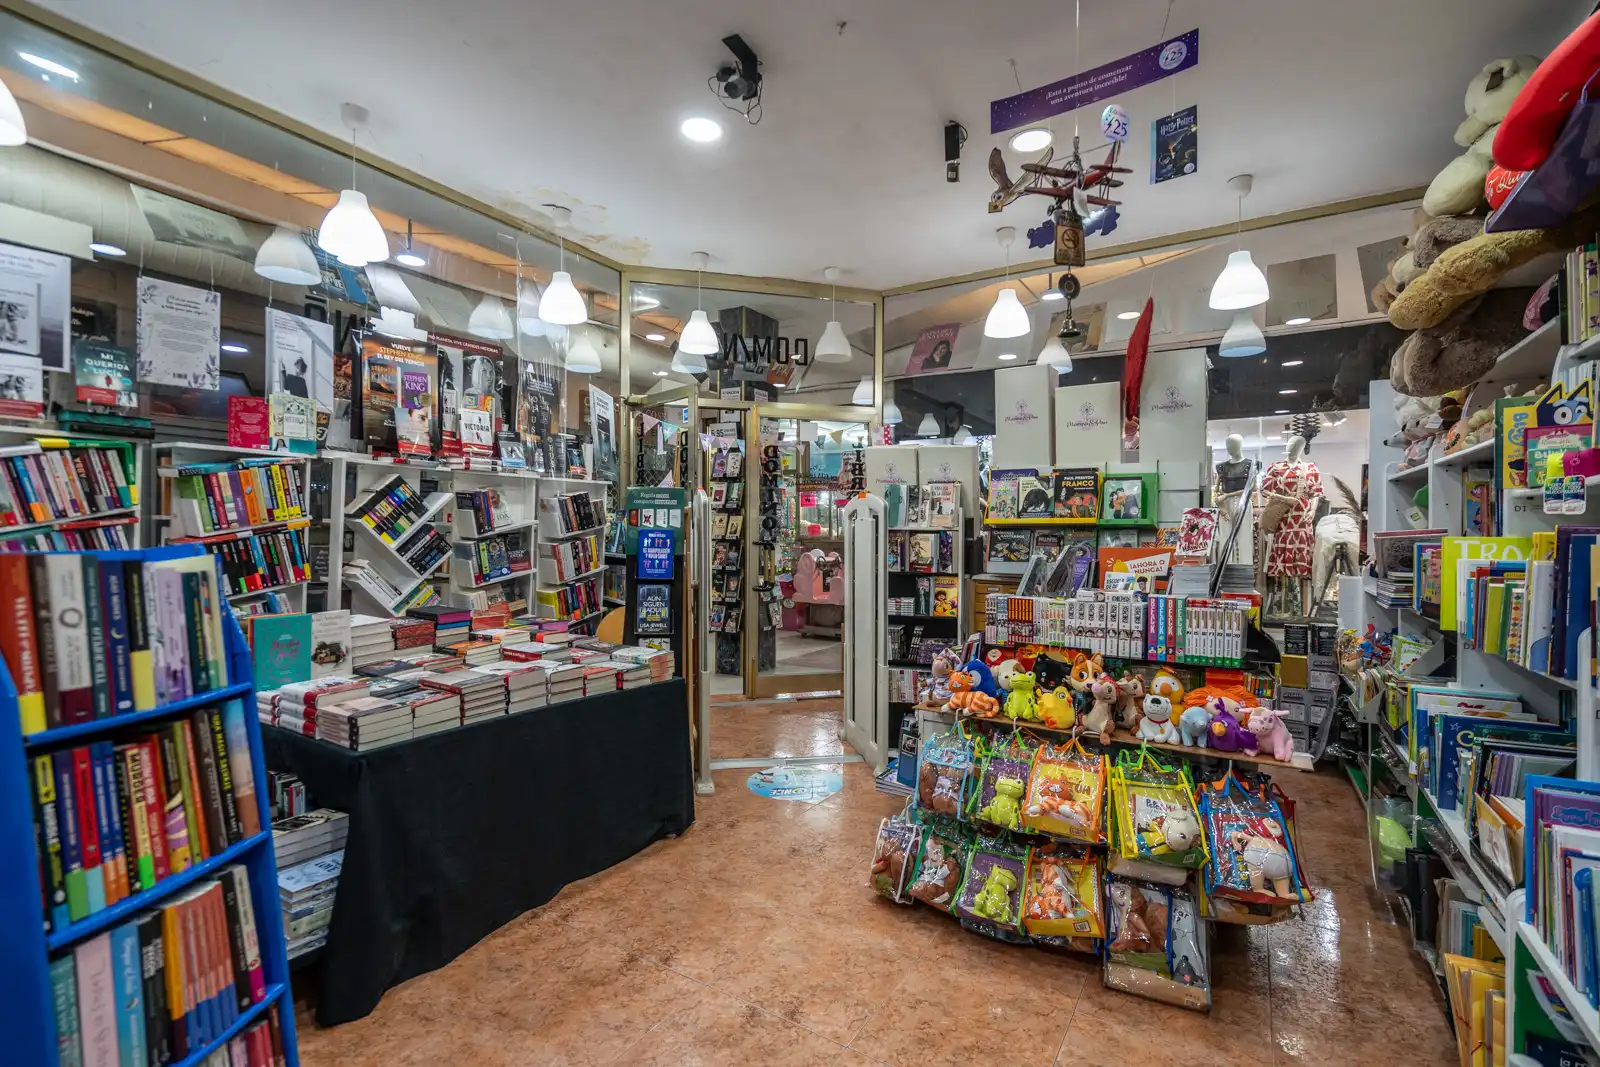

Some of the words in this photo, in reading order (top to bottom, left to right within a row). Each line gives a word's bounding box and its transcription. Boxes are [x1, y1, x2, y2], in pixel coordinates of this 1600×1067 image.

[1067, 80, 1088, 93] punto
[1088, 76, 1098, 84] de
[1098, 64, 1133, 80] comenzar
[1050, 97, 1063, 105] una
[1063, 87, 1093, 101] aventura
[1094, 73, 1128, 90] increíble!
[1113, 118, 1128, 137] 25
[380, 347, 407, 356] STEPHEN
[85, 358, 130, 371] QUERIDA
[404, 374, 427, 383] STEPHEN
[405, 382, 426, 392] KING
[464, 423, 490, 432] VICTORIA
[1129, 560, 1157, 570] ¡AHORA
[1134, 566, 1163, 576] NUNCA!
[130, 754, 144, 804] MURDER
